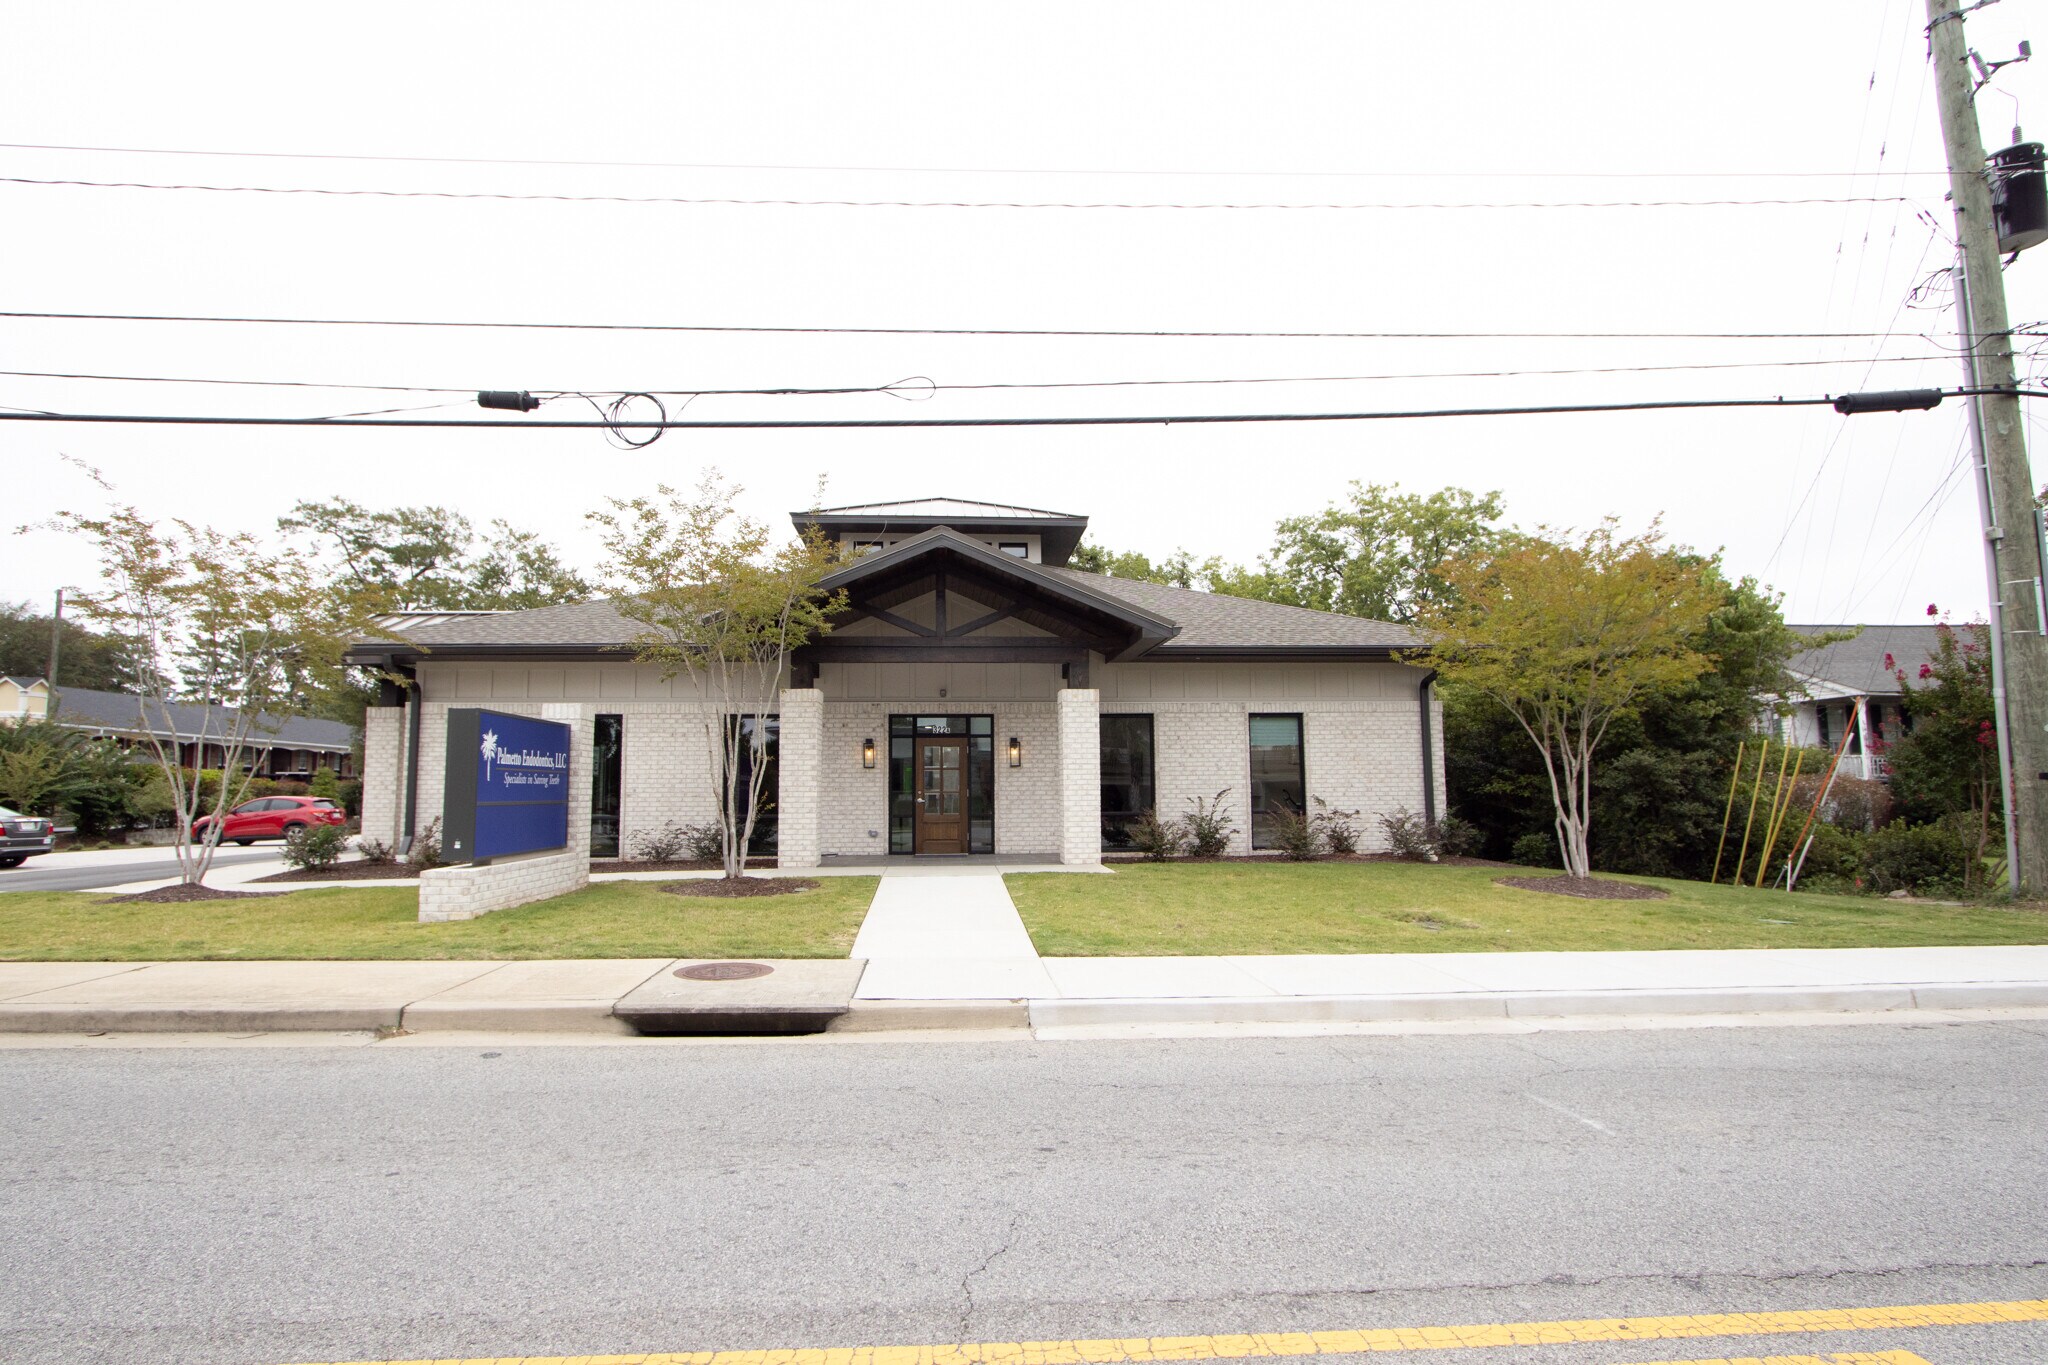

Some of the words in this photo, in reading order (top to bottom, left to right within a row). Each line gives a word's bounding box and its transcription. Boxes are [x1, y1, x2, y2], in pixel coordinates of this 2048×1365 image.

[497, 747, 521, 766] Palmetto
[522, 749, 555, 770] Endodontics,
[555, 752, 567, 768] LLC
[503, 772, 527, 788] Specialists
[527, 773, 533, 784] in
[533, 773, 549, 788] Saving
[549, 774, 560, 785] Teeth
